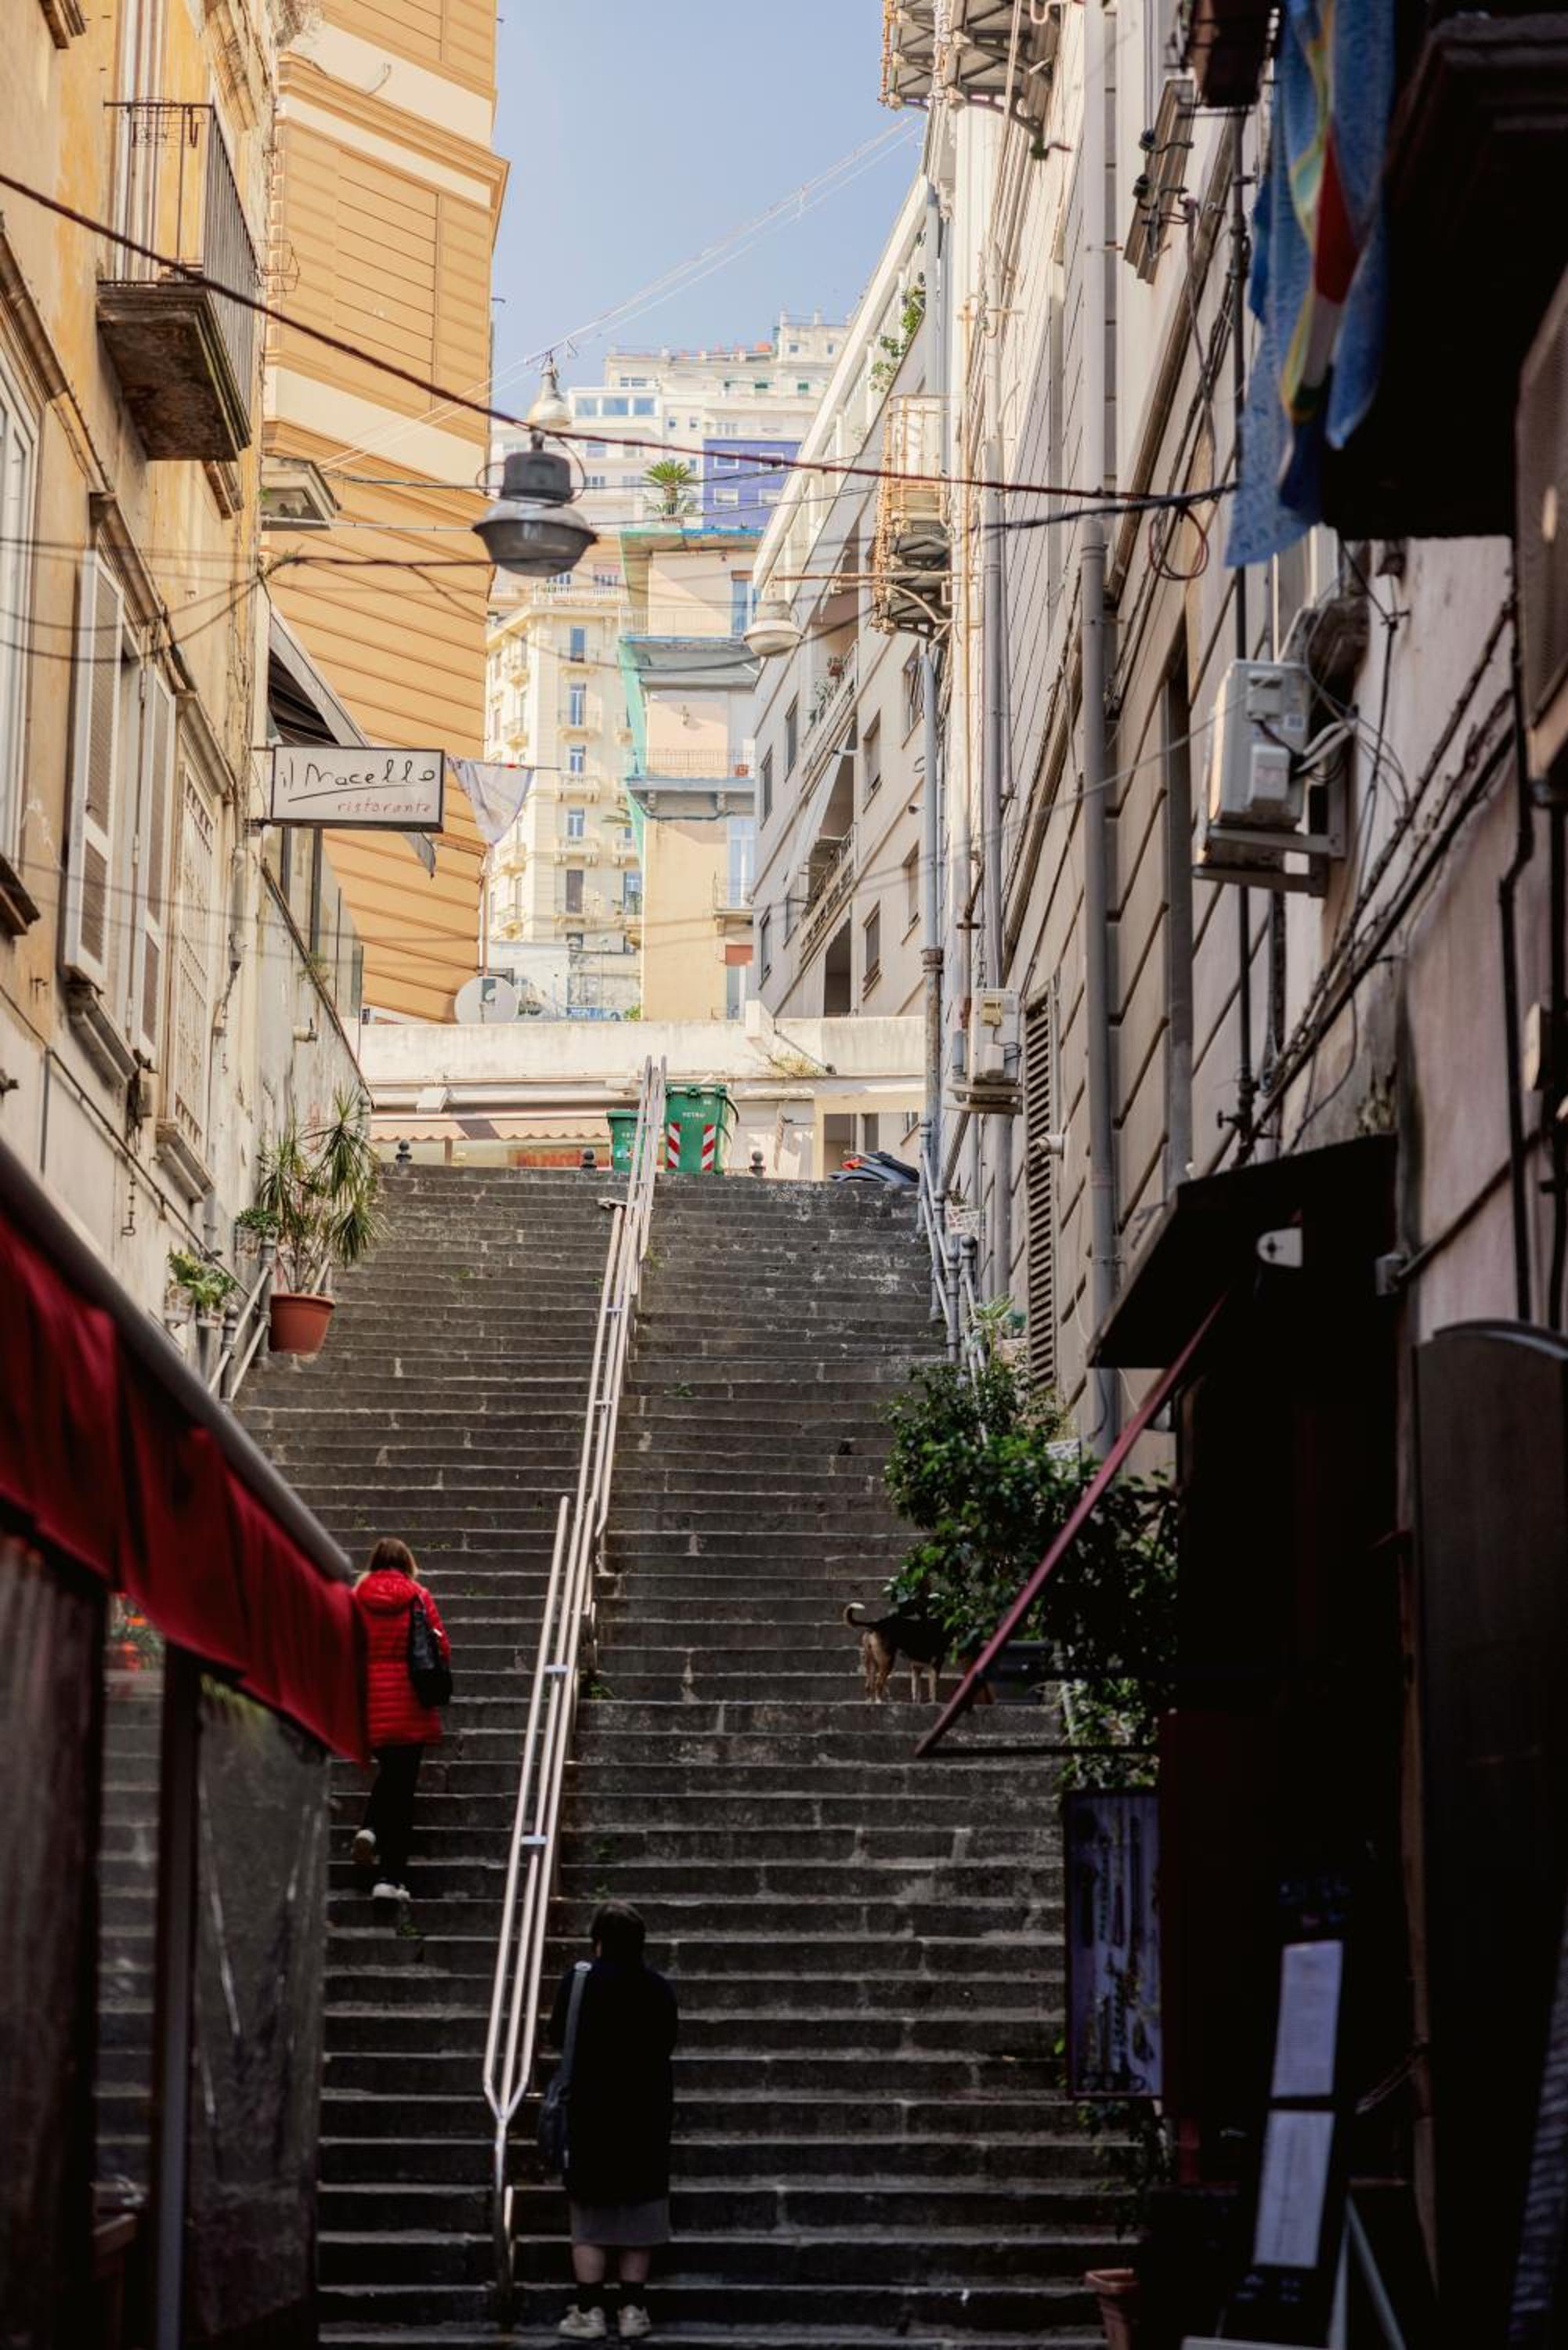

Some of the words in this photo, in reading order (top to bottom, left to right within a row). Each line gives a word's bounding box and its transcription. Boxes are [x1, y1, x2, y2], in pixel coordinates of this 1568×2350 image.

[280, 758, 294, 790] il
[304, 758, 436, 787] Macello
[338, 797, 432, 813] ristorante
